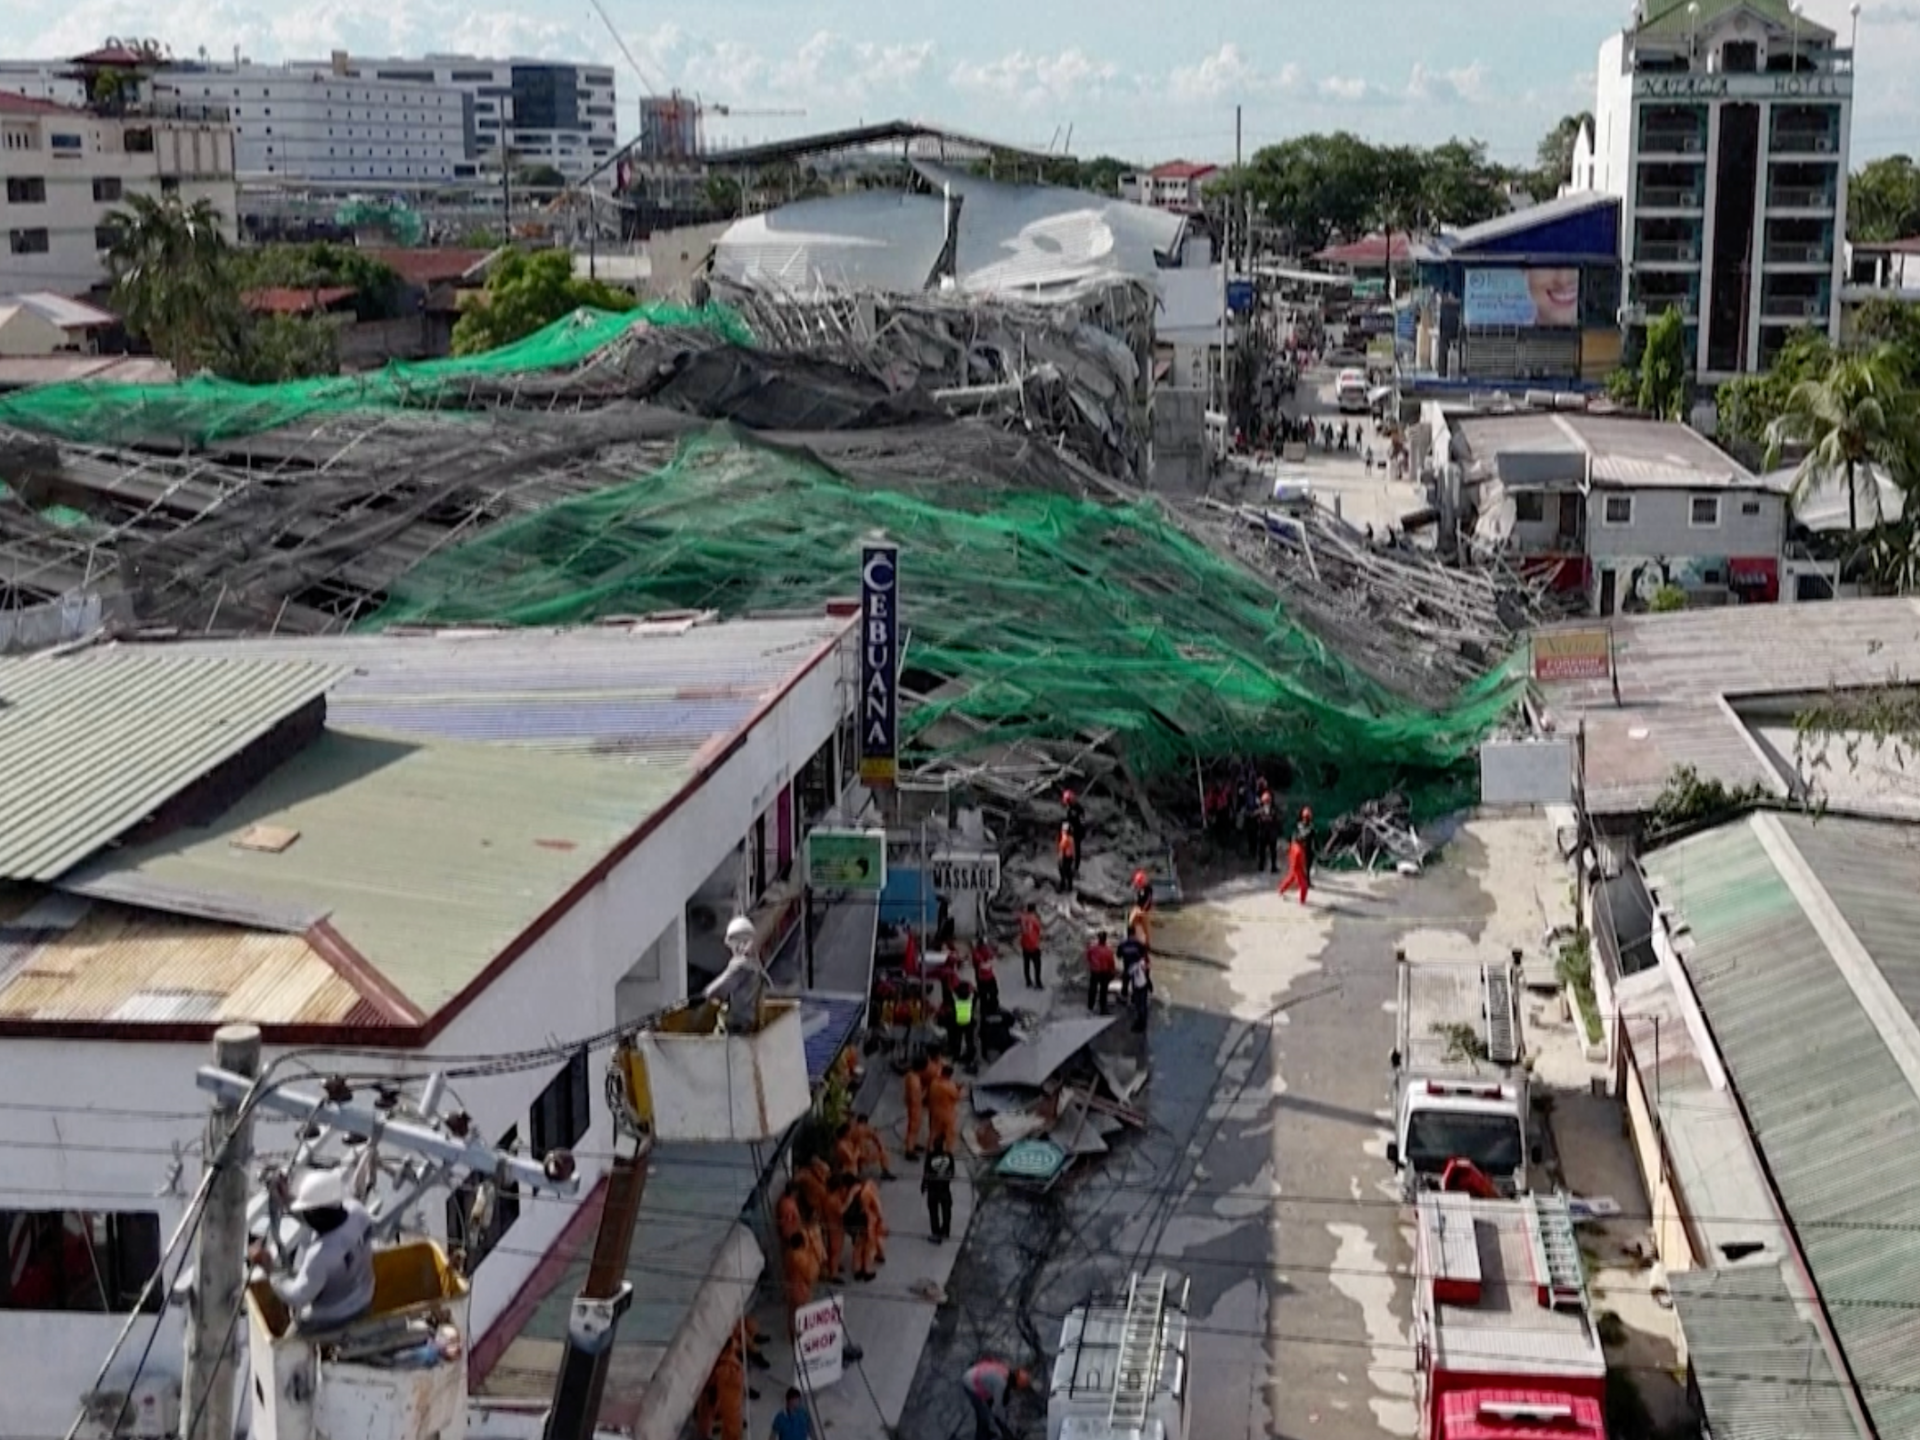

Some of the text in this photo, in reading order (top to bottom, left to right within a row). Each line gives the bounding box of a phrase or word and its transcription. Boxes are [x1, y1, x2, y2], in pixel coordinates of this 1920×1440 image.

[1774, 76, 1838, 97] HOTEL
[863, 556, 894, 744] CEBUANA
[933, 868, 993, 890] MASSAGE
[803, 1332, 837, 1353] SHOP
